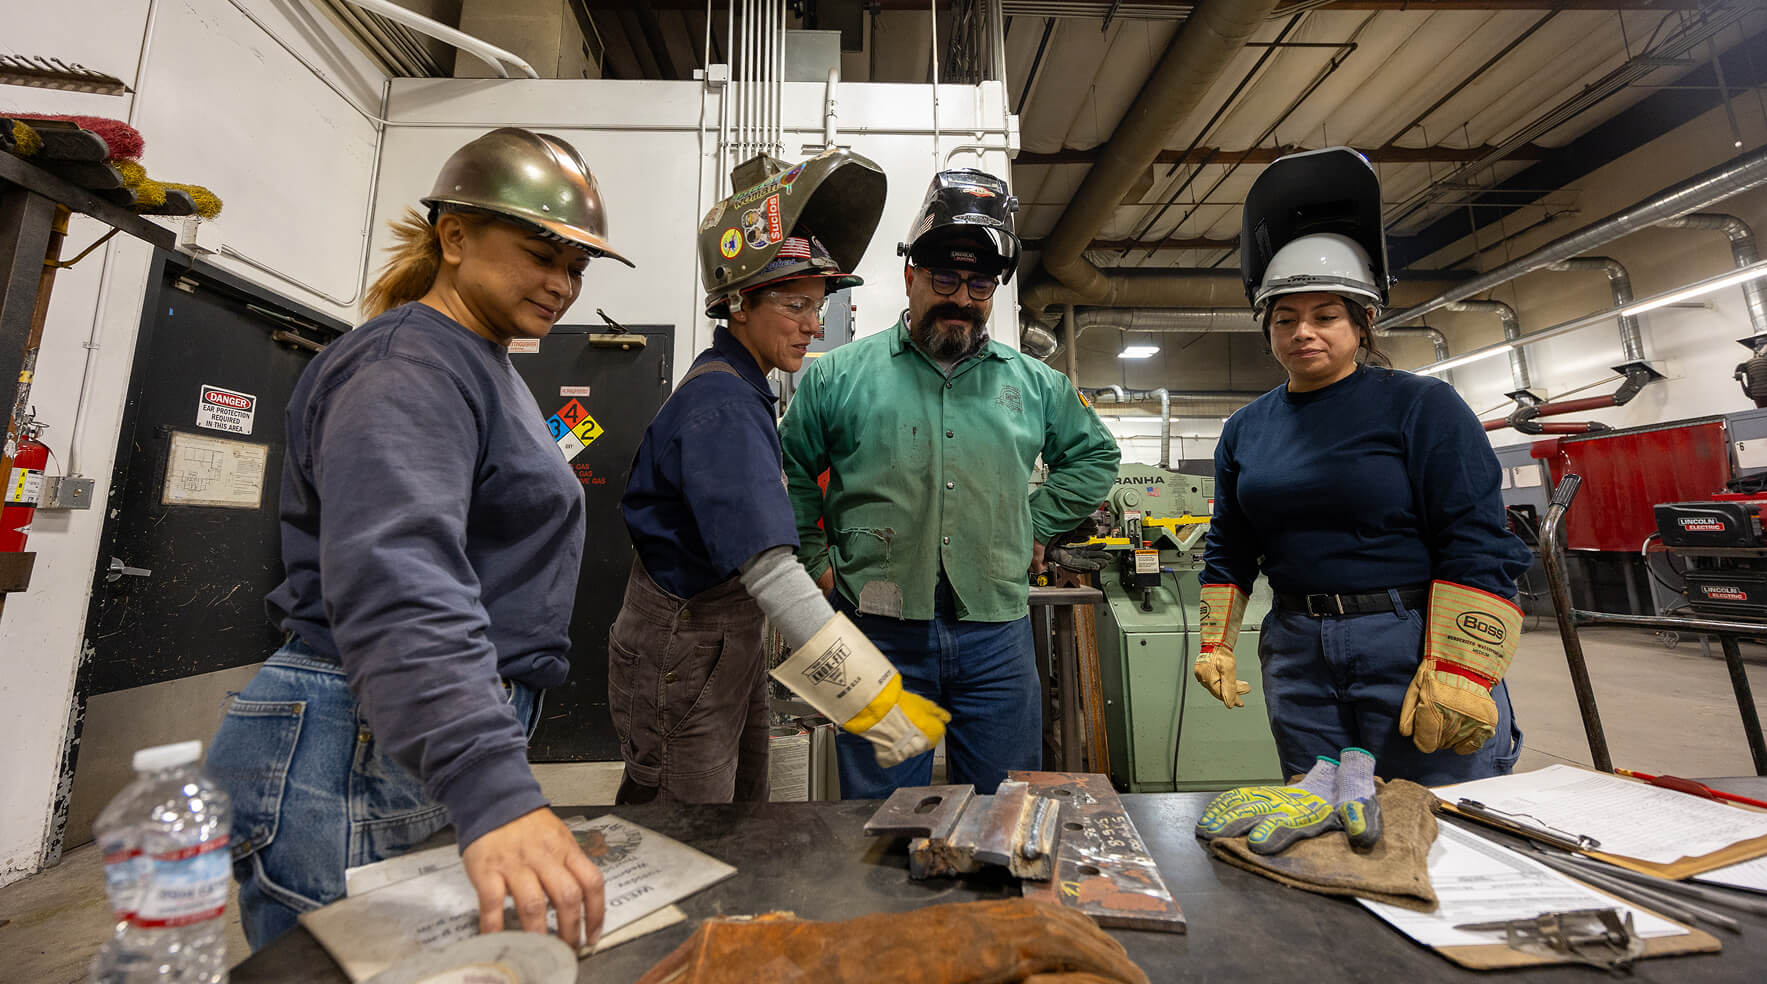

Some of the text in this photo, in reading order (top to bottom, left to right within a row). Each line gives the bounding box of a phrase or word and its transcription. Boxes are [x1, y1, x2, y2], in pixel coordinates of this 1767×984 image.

[210, 392, 247, 408] DANGER
[202, 404, 250, 419] EAR PROTECTION
[211, 413, 241, 425] REQUIRED
[564, 403, 578, 423] 4
[214, 422, 228, 430] THIS
[228, 424, 243, 432] AREA
[549, 418, 595, 440] 3 2
[1114, 476, 1165, 485] RANHA
[610, 886, 655, 907] WELD
